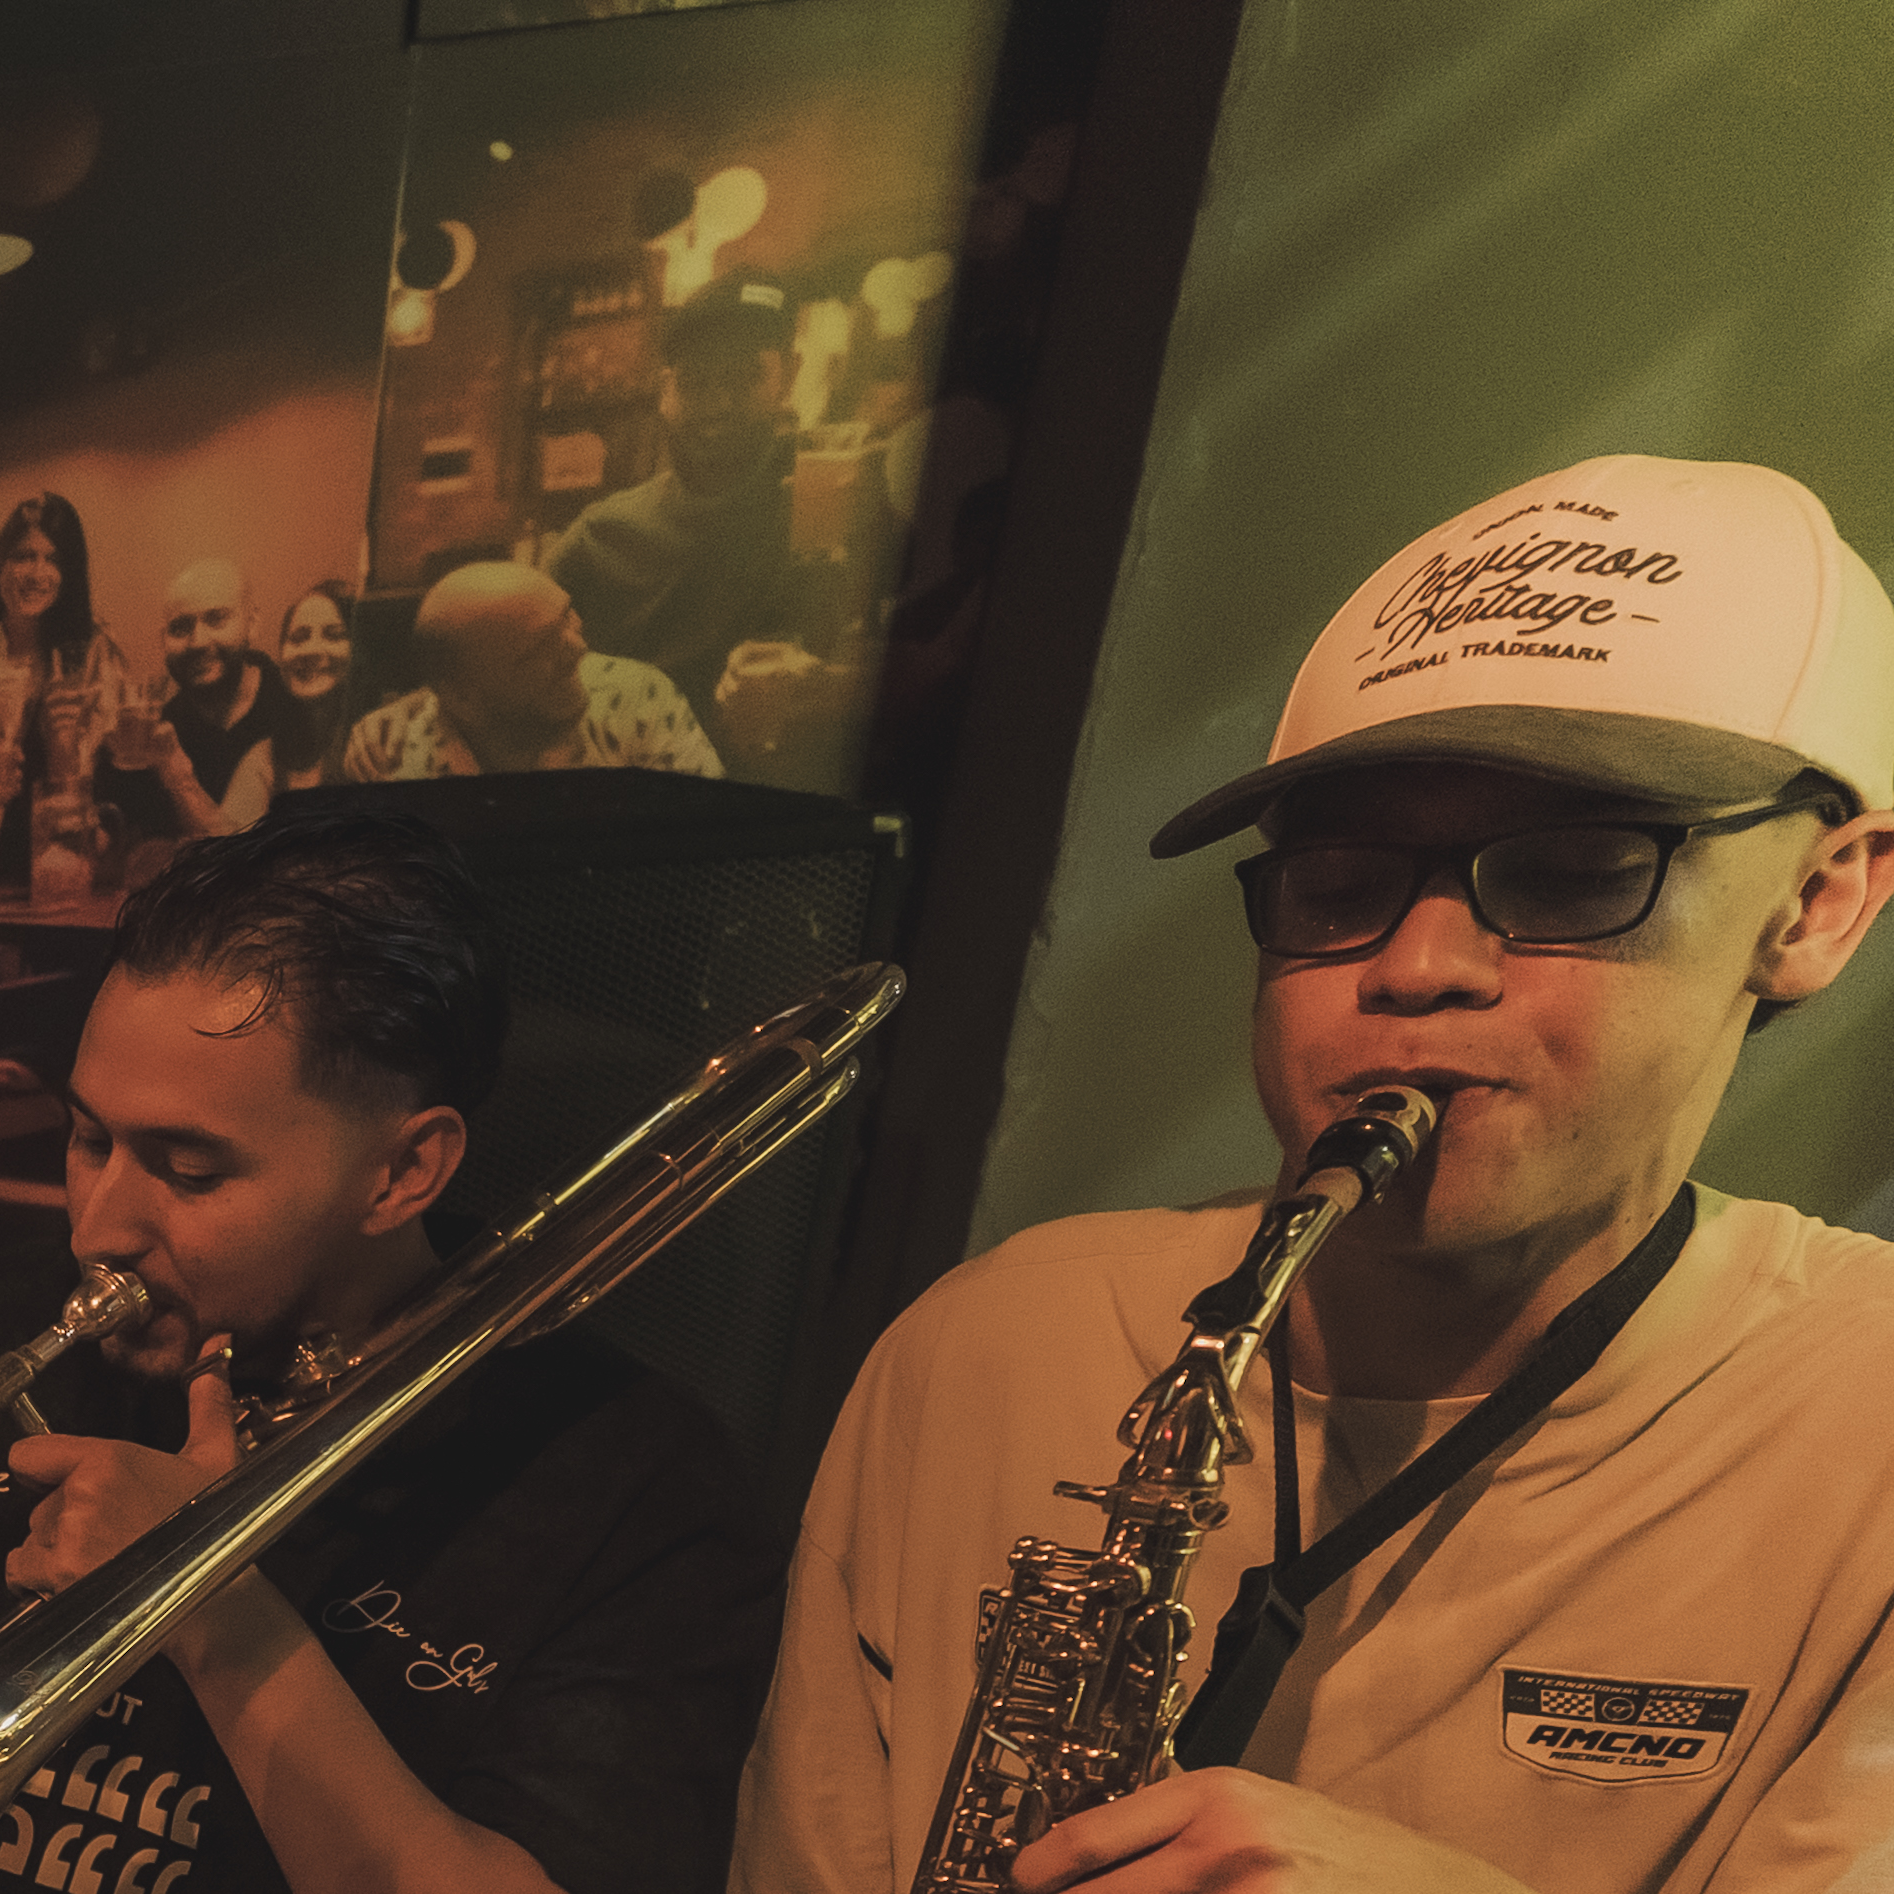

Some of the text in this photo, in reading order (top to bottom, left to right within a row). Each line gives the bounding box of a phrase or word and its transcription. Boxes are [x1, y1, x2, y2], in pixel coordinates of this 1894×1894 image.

[1553, 500, 1620, 522] MADE
[1373, 532, 1684, 630] Chevignon
[1379, 582, 1617, 661] Heritage
[1358, 639, 1613, 692] ORIGINAL TRADEMARK
[1517, 1675, 1741, 1702] INTERNATIONAL SPEEDWAY
[1548, 1750, 1617, 1765] RACING
